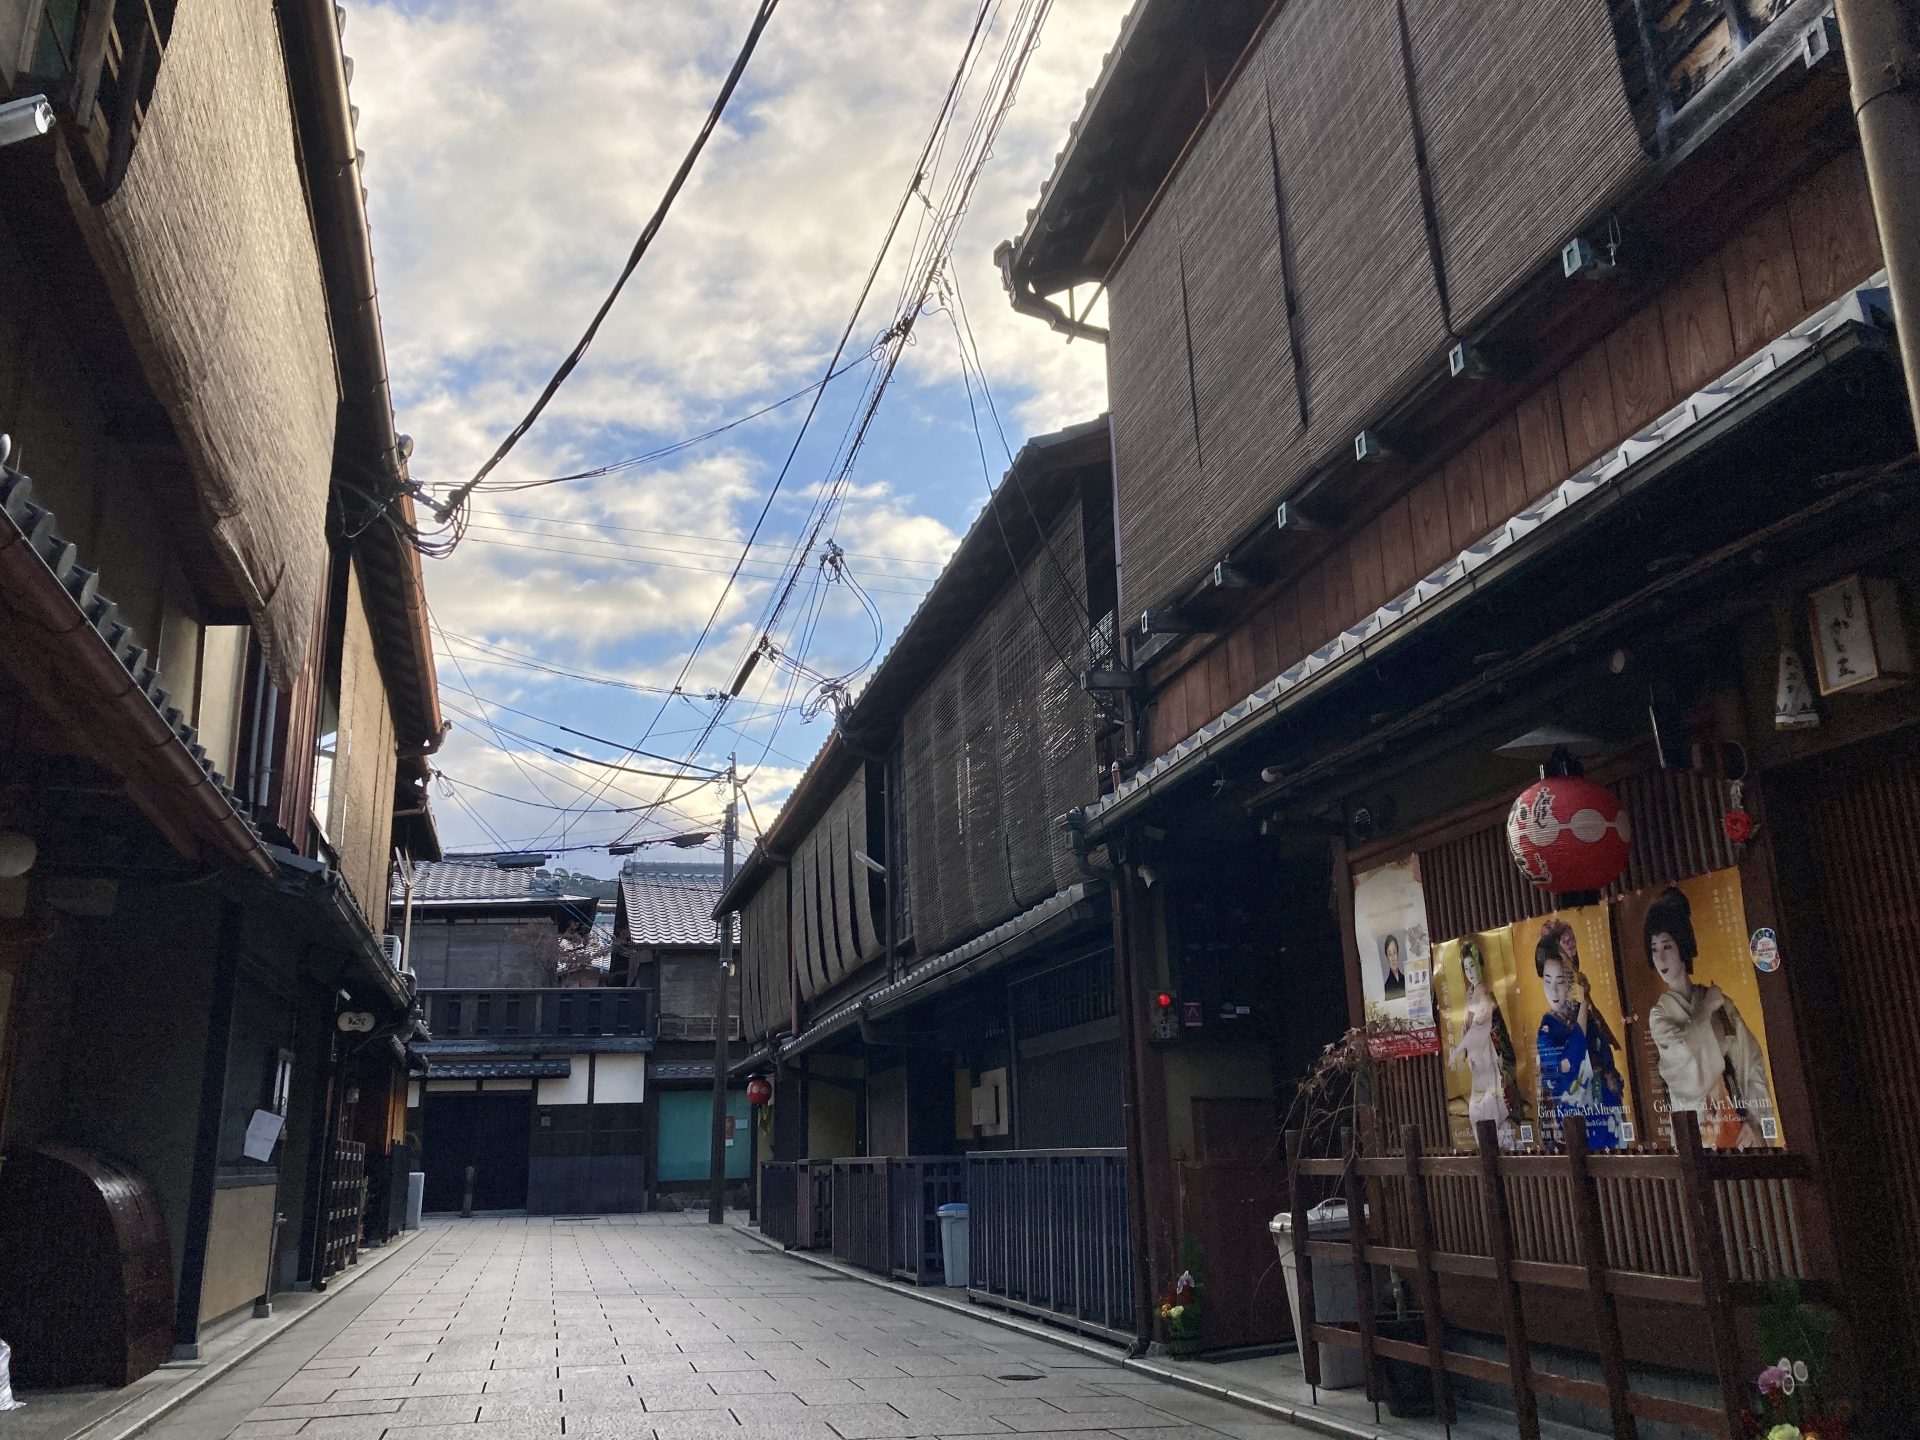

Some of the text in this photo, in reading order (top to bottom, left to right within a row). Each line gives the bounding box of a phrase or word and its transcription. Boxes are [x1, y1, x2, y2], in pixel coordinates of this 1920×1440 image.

[1538, 1103, 1631, 1119] Gion Kagai Art Museum
[1709, 1096, 1725, 1111] Art
[1726, 1096, 1772, 1109] Museum
